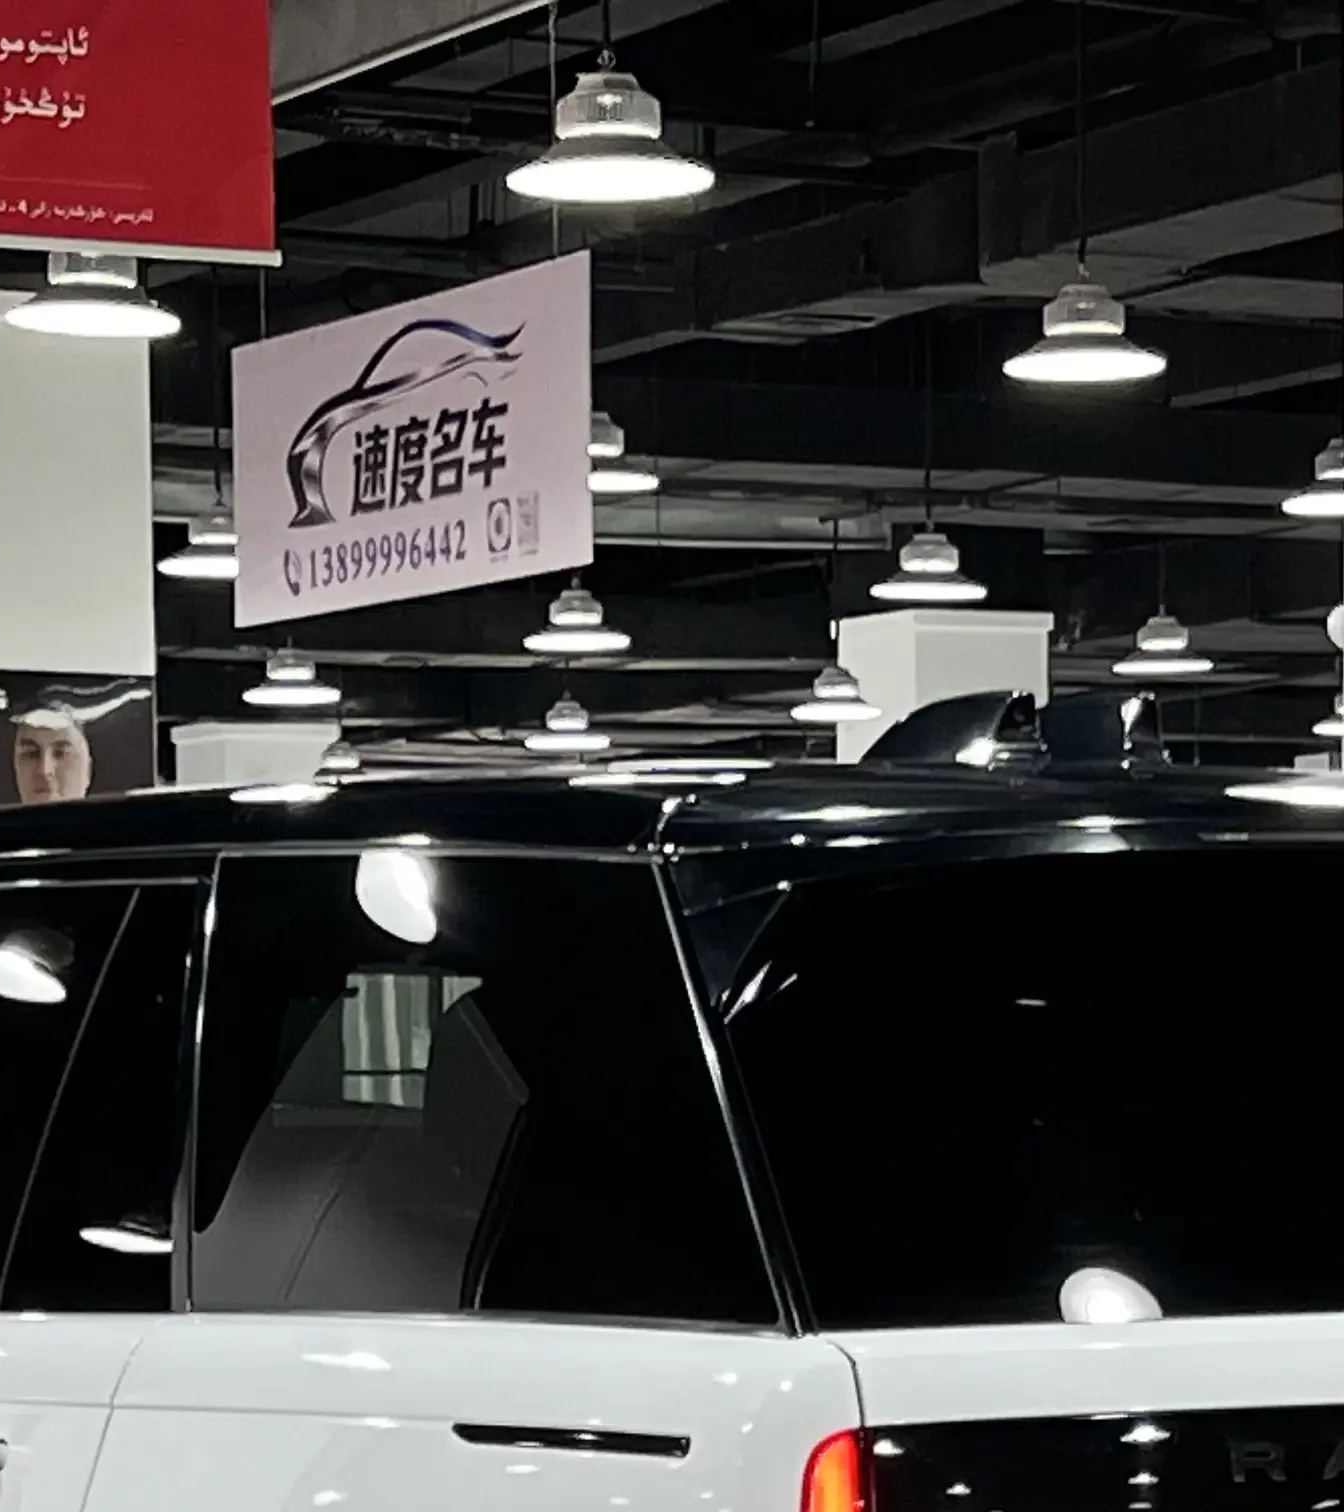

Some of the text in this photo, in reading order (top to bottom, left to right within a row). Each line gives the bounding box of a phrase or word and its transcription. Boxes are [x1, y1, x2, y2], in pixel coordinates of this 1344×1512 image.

[350, 397, 509, 518] 速度名车
[308, 520, 468, 591] 13899996442
